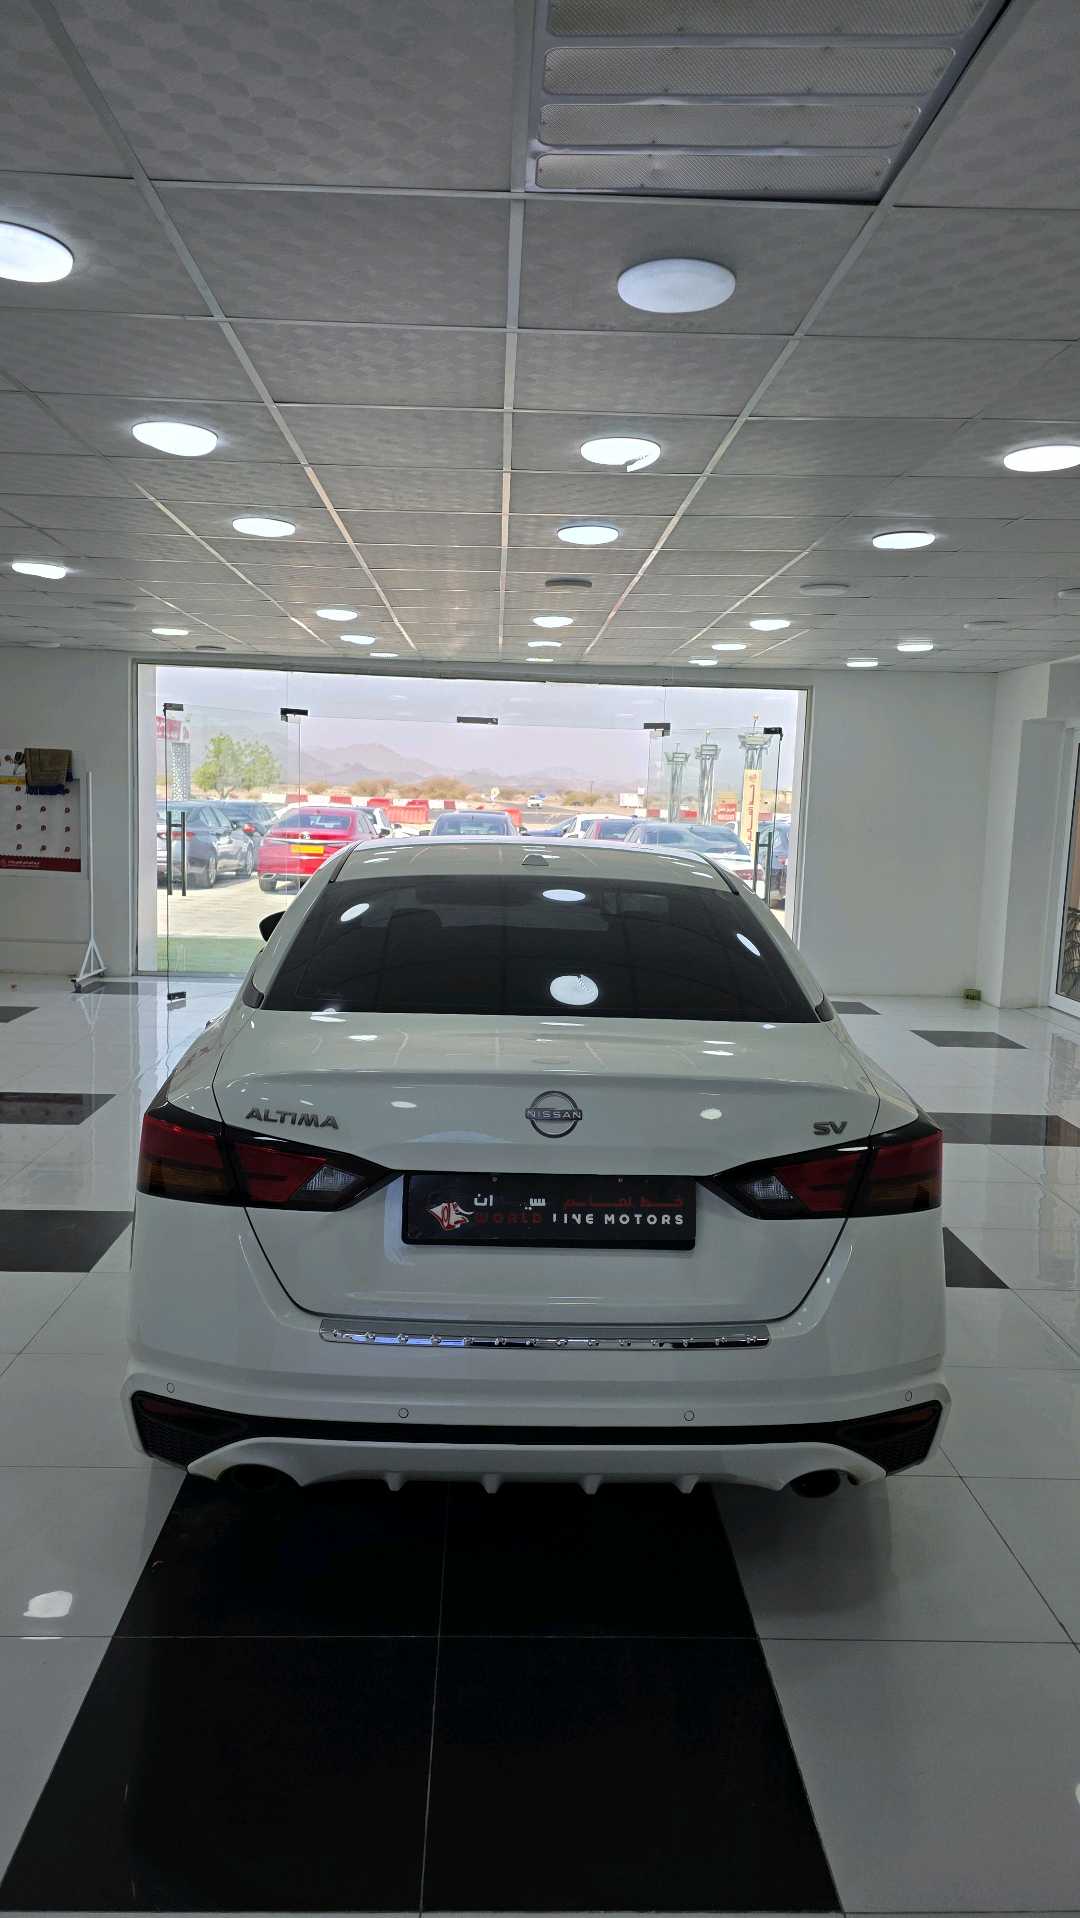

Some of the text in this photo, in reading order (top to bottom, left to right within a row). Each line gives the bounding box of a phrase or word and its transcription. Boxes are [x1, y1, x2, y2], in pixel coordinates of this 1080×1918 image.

[245, 1107, 339, 1129] ALTIMA
[527, 1109, 581, 1119] NISSAN
[813, 1121, 848, 1136] SV
[604, 1214, 684, 1225] MOTORS
